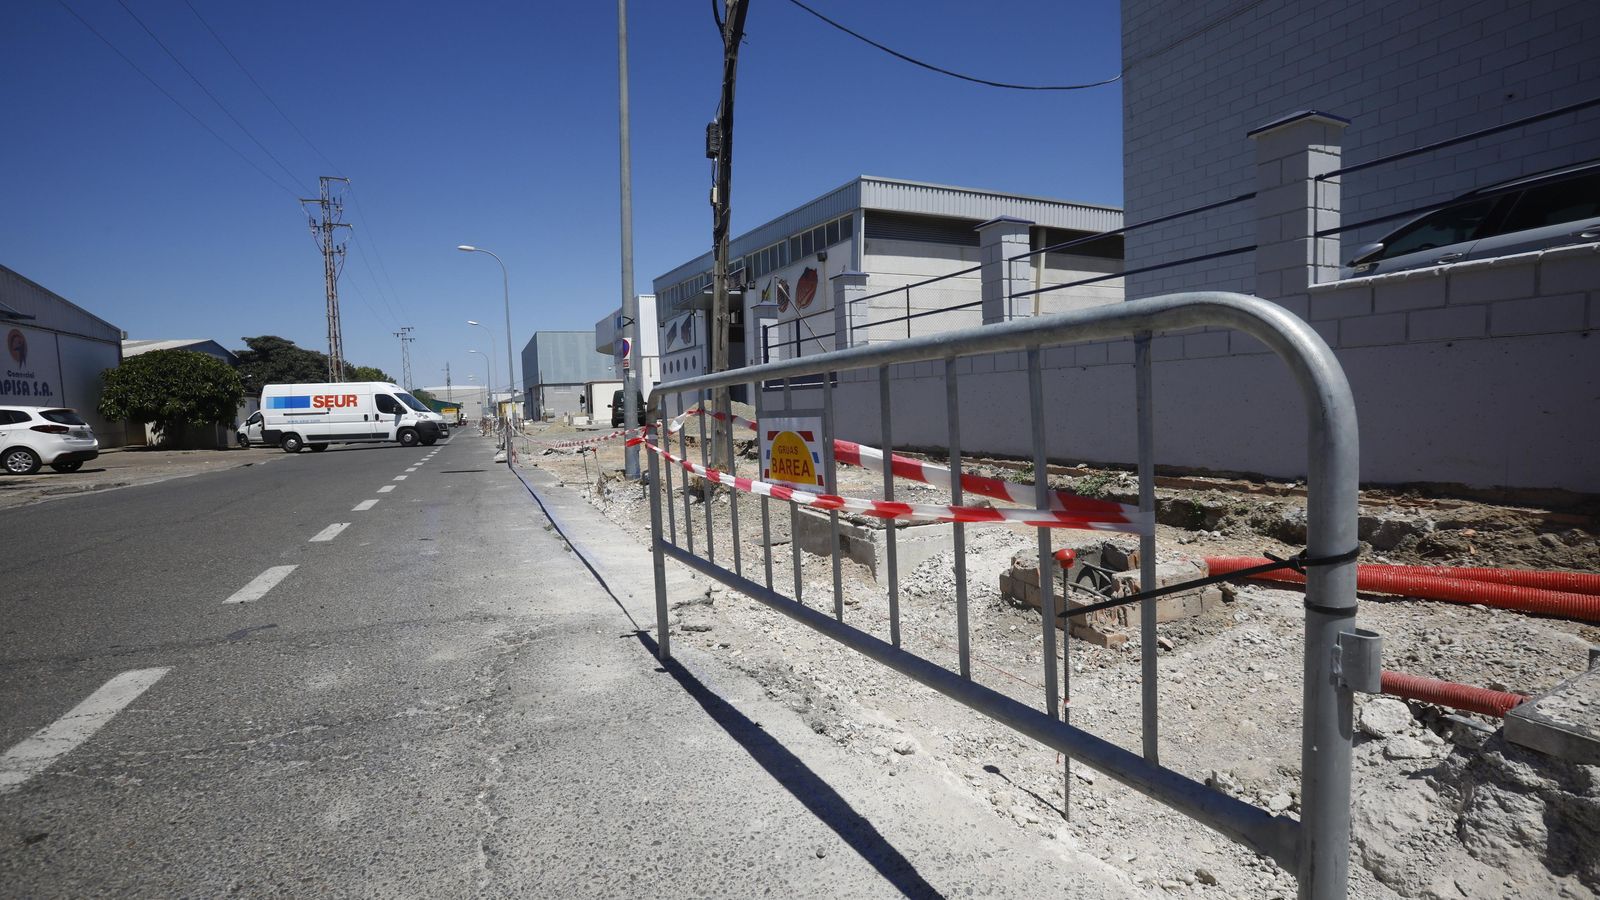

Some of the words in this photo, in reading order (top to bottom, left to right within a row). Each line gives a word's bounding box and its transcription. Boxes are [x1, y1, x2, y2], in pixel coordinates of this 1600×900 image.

[7, 369, 35, 378] Comercial
[33, 381, 53, 397] S.A.
[312, 394, 357, 408] SEUR
[778, 445, 799, 455] GRUAS
[772, 457, 811, 478] BAREA
